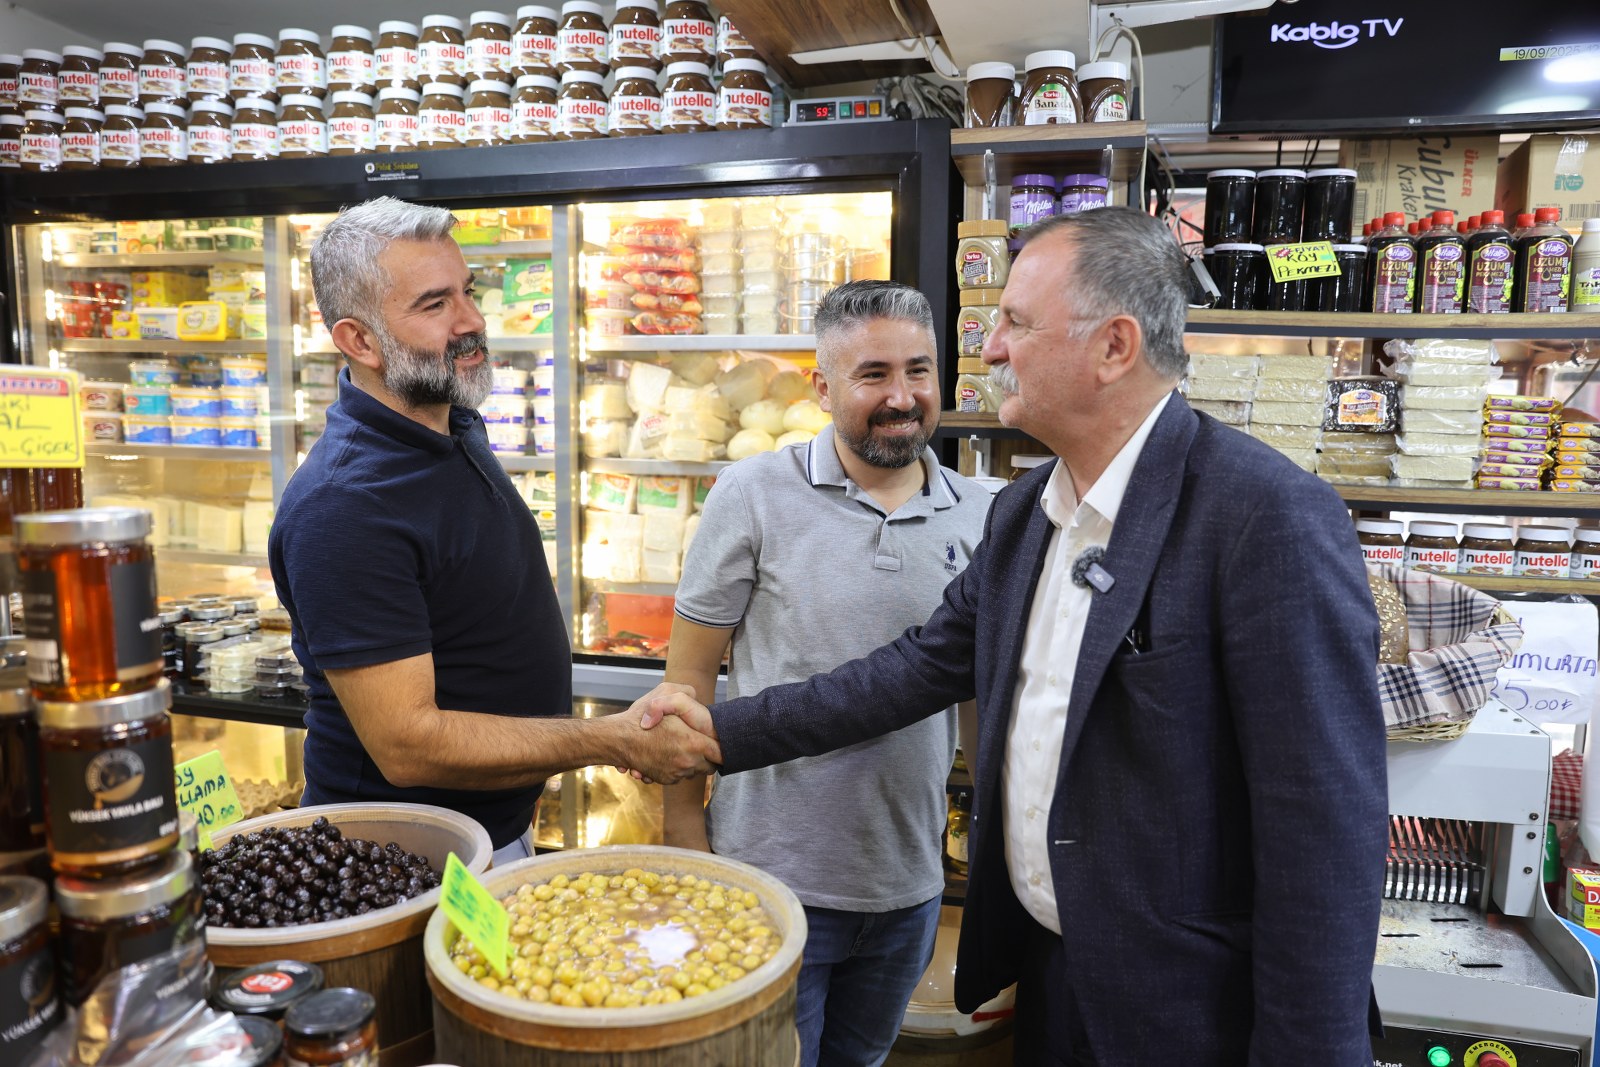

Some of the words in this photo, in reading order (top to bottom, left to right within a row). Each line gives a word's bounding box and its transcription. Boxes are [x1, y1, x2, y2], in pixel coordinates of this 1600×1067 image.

[616, 27, 661, 43] nutella
[667, 22, 713, 37] nutella
[1270, 21, 1360, 42] Kablo
[1362, 17, 1405, 38] TV
[559, 32, 605, 46] nutella
[276, 57, 319, 71] nutella
[328, 54, 372, 69] nutella
[141, 68, 186, 82] nutella
[232, 63, 276, 77] nutella
[22, 76, 58, 91] nutell
[613, 98, 661, 113] nutella
[666, 93, 713, 108] nutella
[725, 91, 770, 108] nutella
[279, 122, 320, 136] nutella
[328, 119, 369, 133] nutella
[232, 127, 276, 141] nutella
[1460, 148, 1479, 198] ÜLKER
[1396, 163, 1421, 221] Kraker
[1024, 199, 1053, 215] Milka
[1361, 547, 1403, 560] nutella
[1411, 551, 1457, 563] nutella
[1466, 551, 1512, 565] nutella
[1520, 553, 1569, 567] nutella
[1503, 652, 1597, 677] UMURTA
[1468, 1042, 1513, 1060] EMERGENCY
